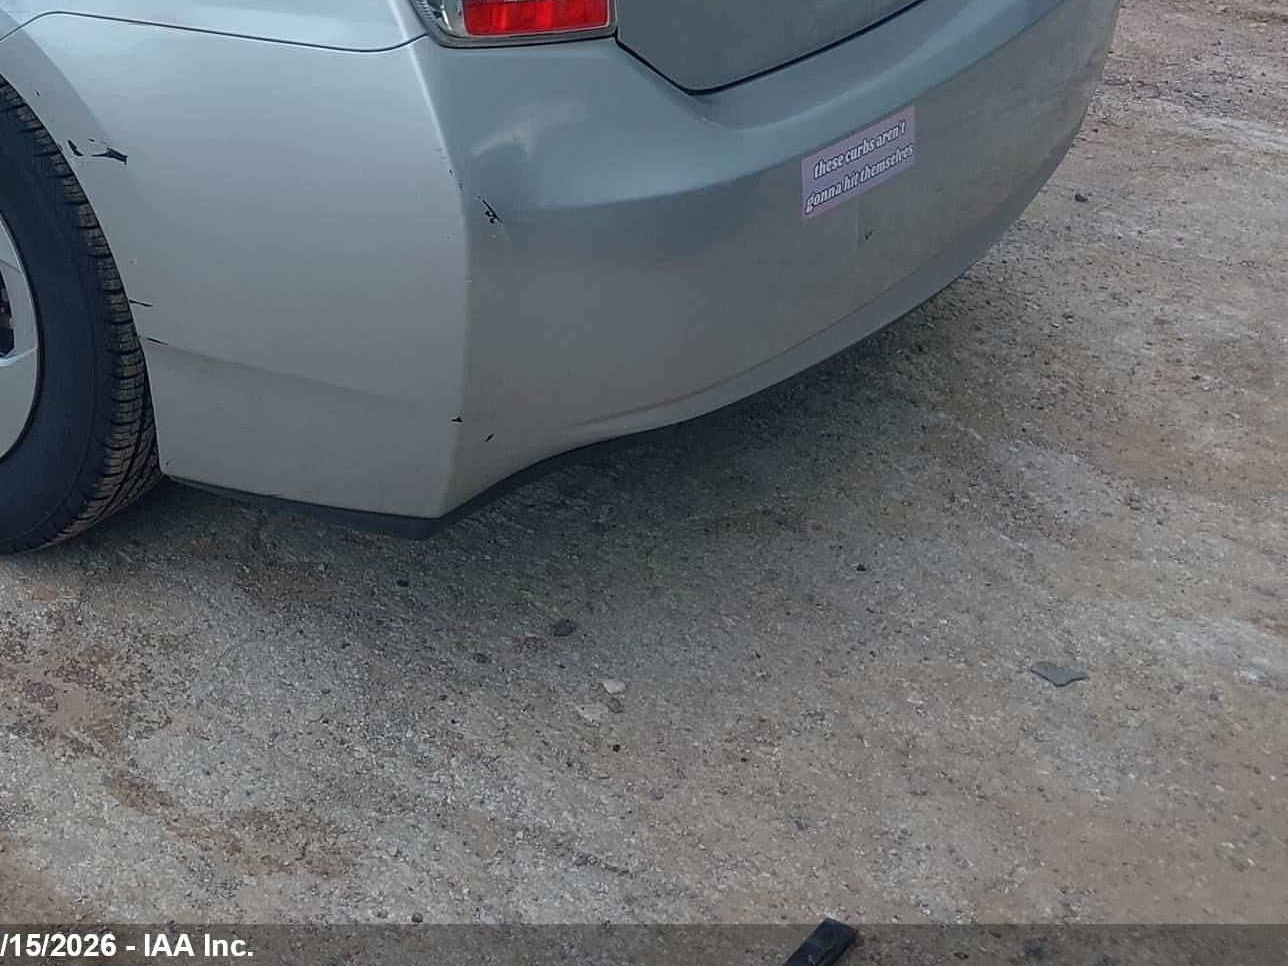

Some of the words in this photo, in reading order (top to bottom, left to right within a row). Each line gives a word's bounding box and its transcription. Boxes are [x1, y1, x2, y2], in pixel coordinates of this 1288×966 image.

[805, 181, 843, 214] gonna
[843, 170, 860, 193] hit
[859, 143, 914, 184] themselves
[814, 154, 844, 179] these
[845, 138, 875, 164] curbs
[875, 119, 906, 148] aren't
